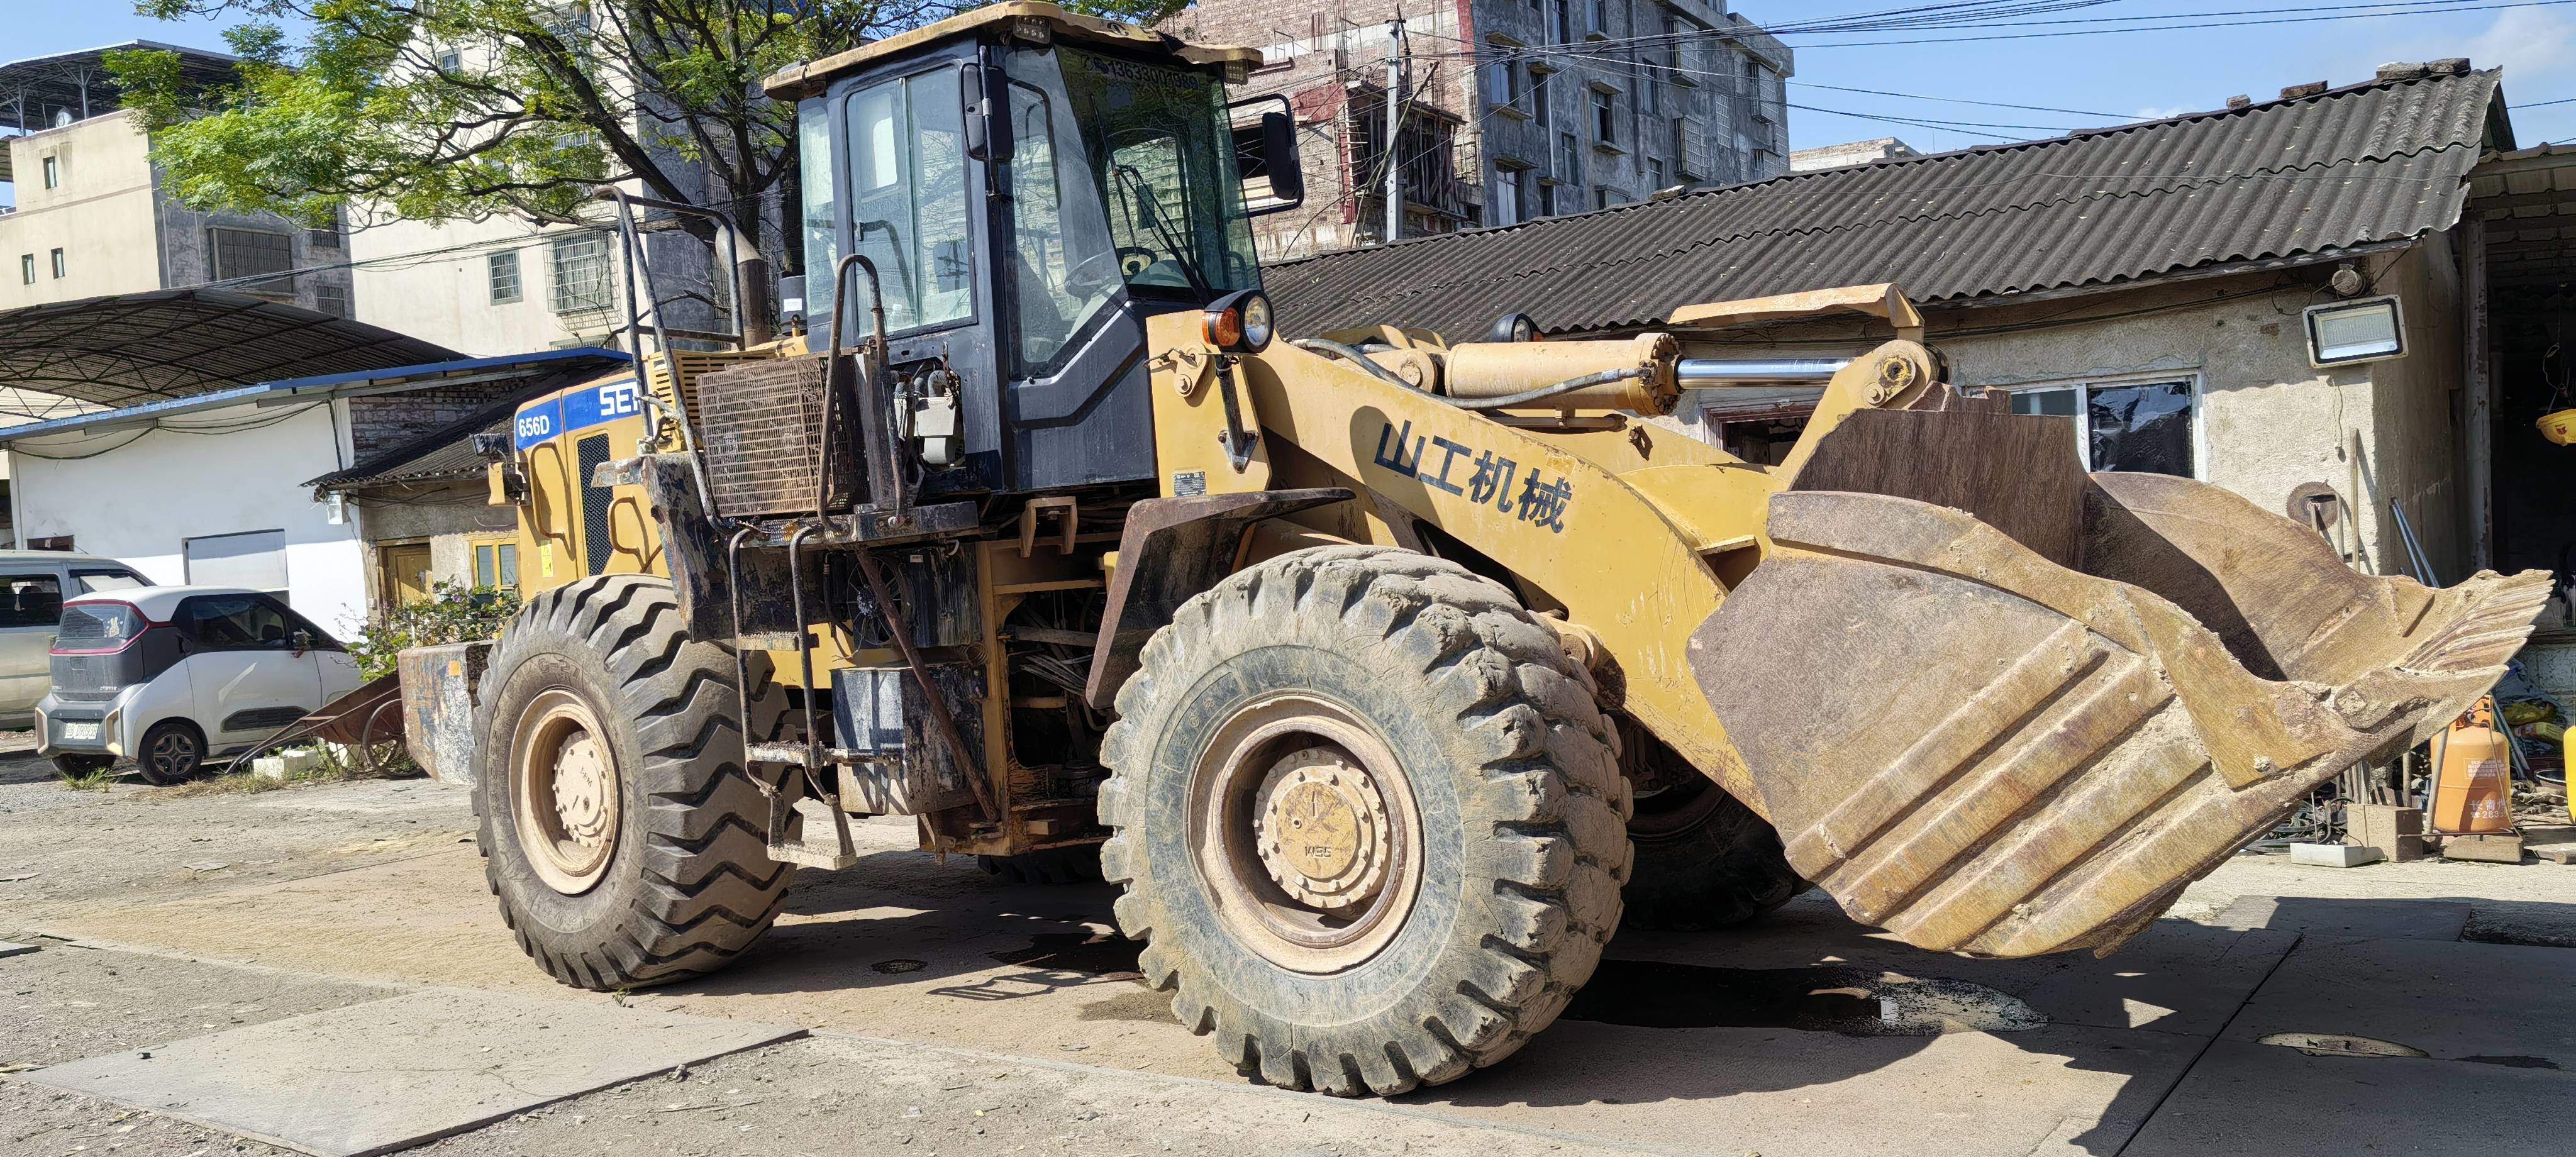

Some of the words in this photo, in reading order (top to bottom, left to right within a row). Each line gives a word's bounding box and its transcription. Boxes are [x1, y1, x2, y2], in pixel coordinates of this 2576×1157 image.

[518, 414, 550, 438] 656D
[1374, 419, 1572, 533] 山工机械
